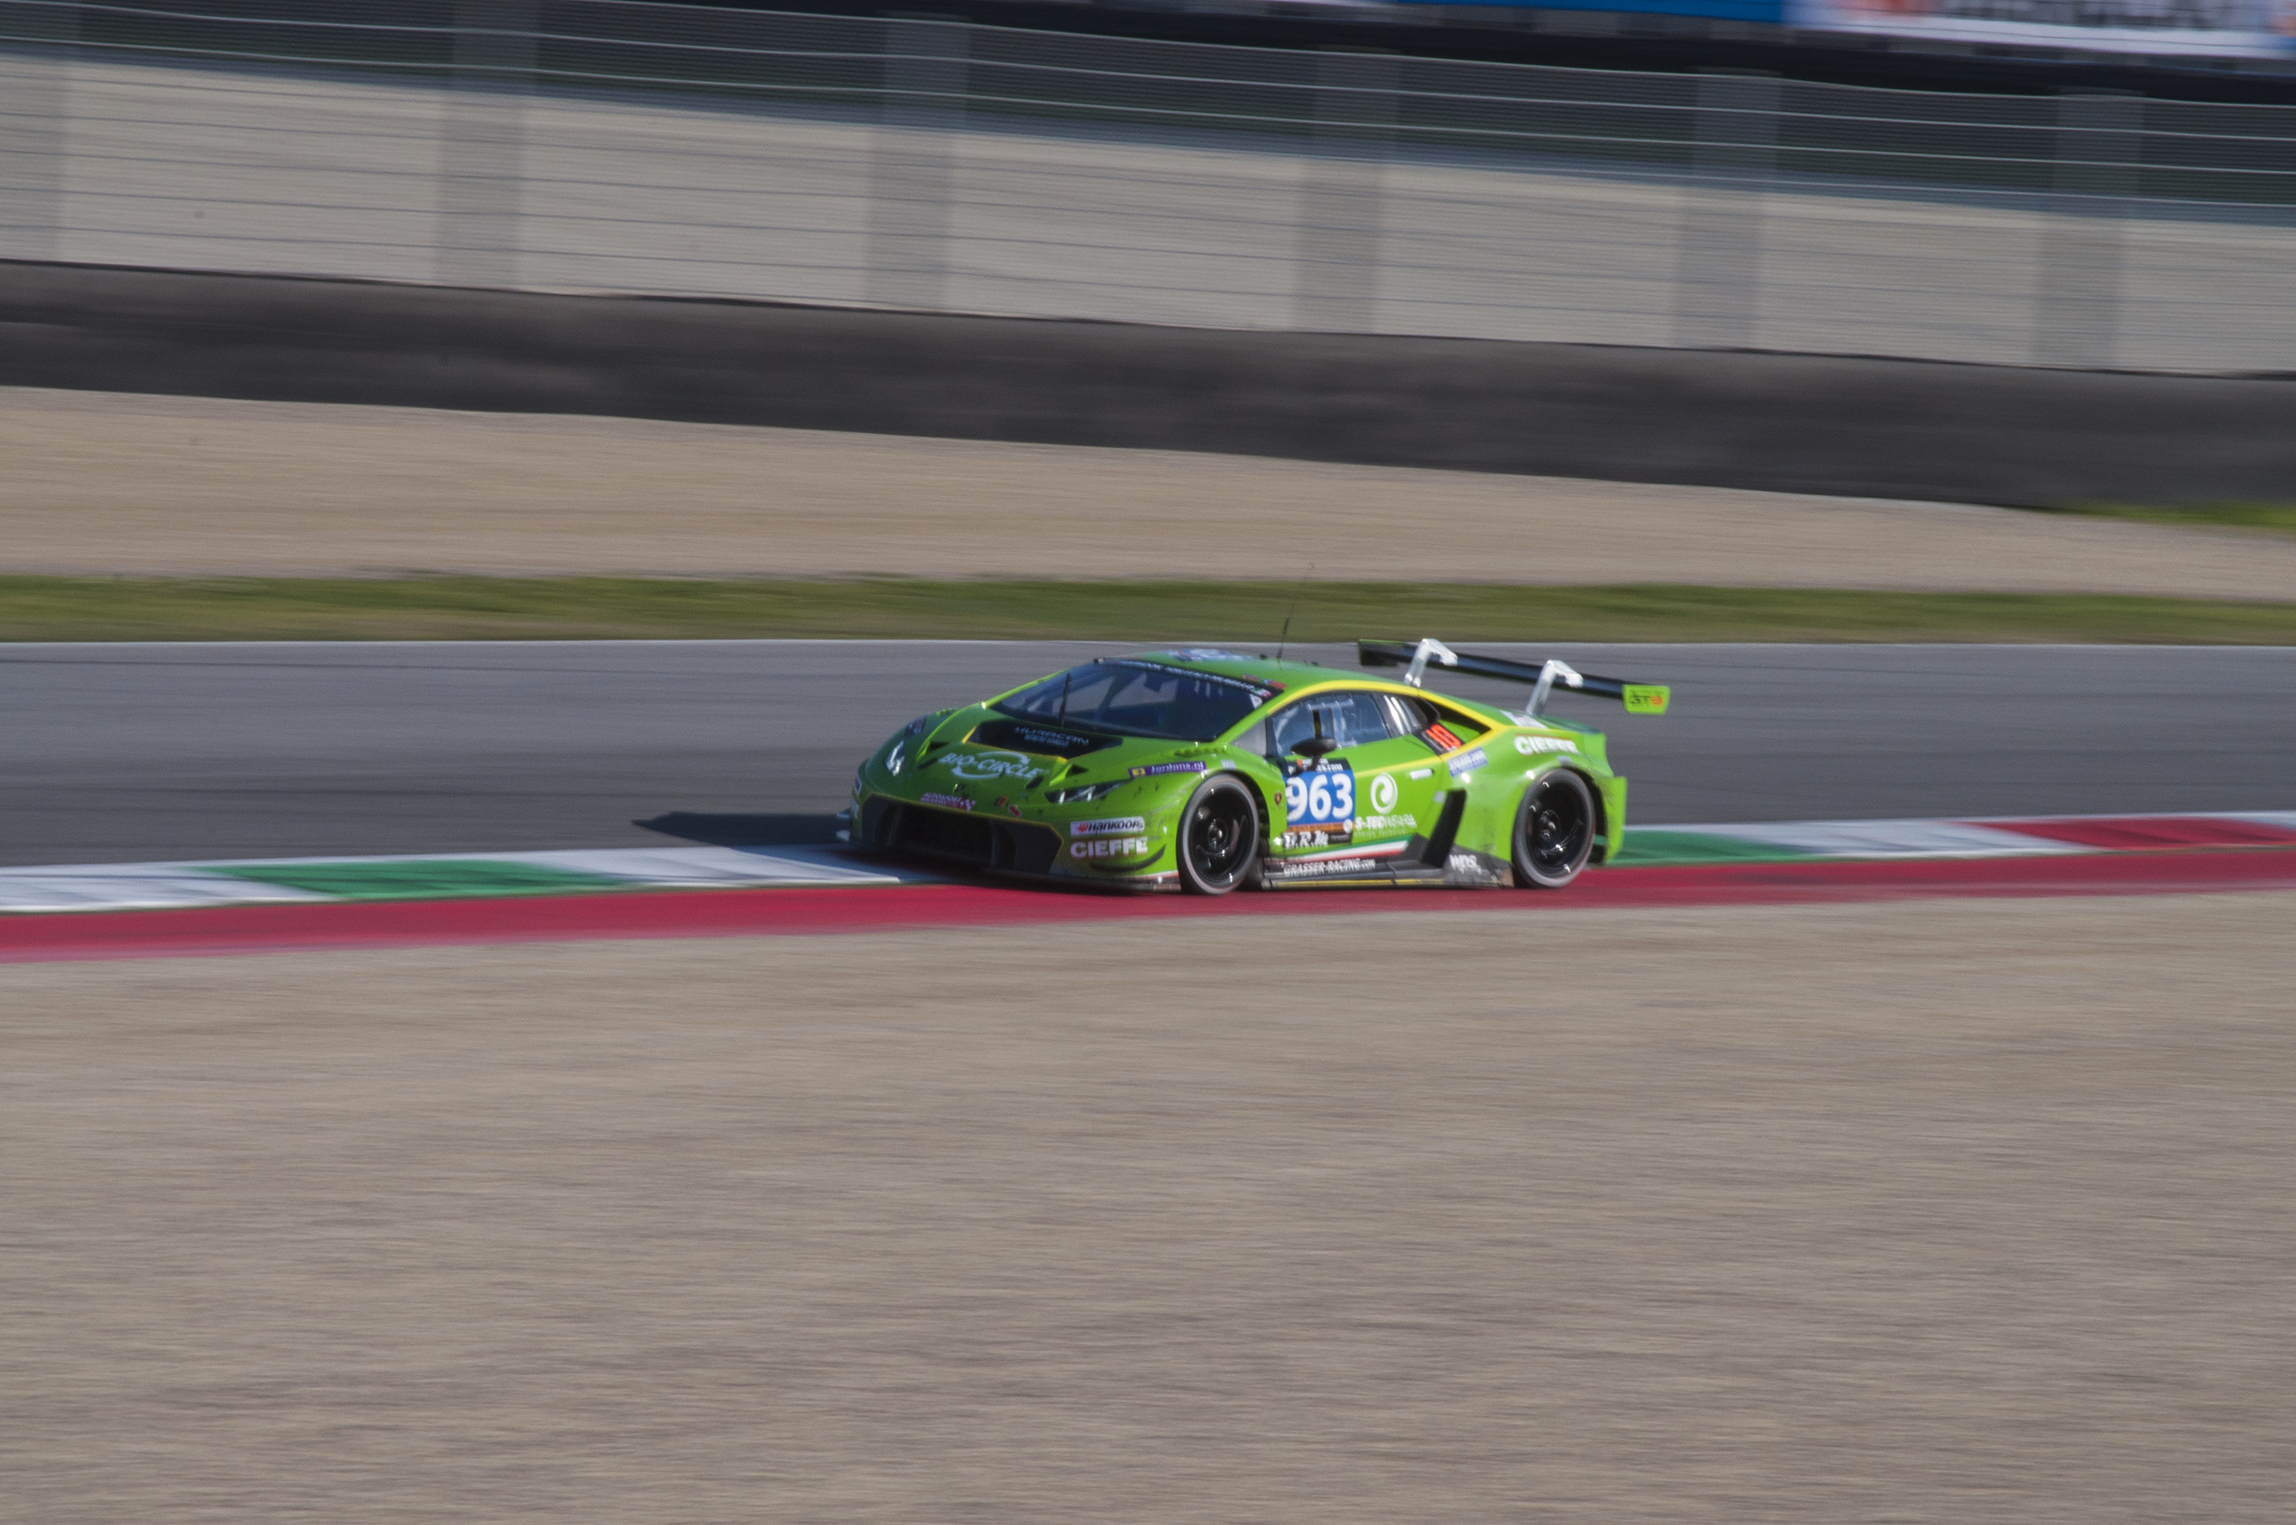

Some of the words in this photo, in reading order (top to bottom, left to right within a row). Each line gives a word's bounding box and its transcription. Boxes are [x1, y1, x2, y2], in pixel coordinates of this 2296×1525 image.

[938, 752, 1043, 778] BIO-CIRCLE
[1285, 773, 1353, 822] 963
[1070, 836, 1148, 858] CIEFFE
